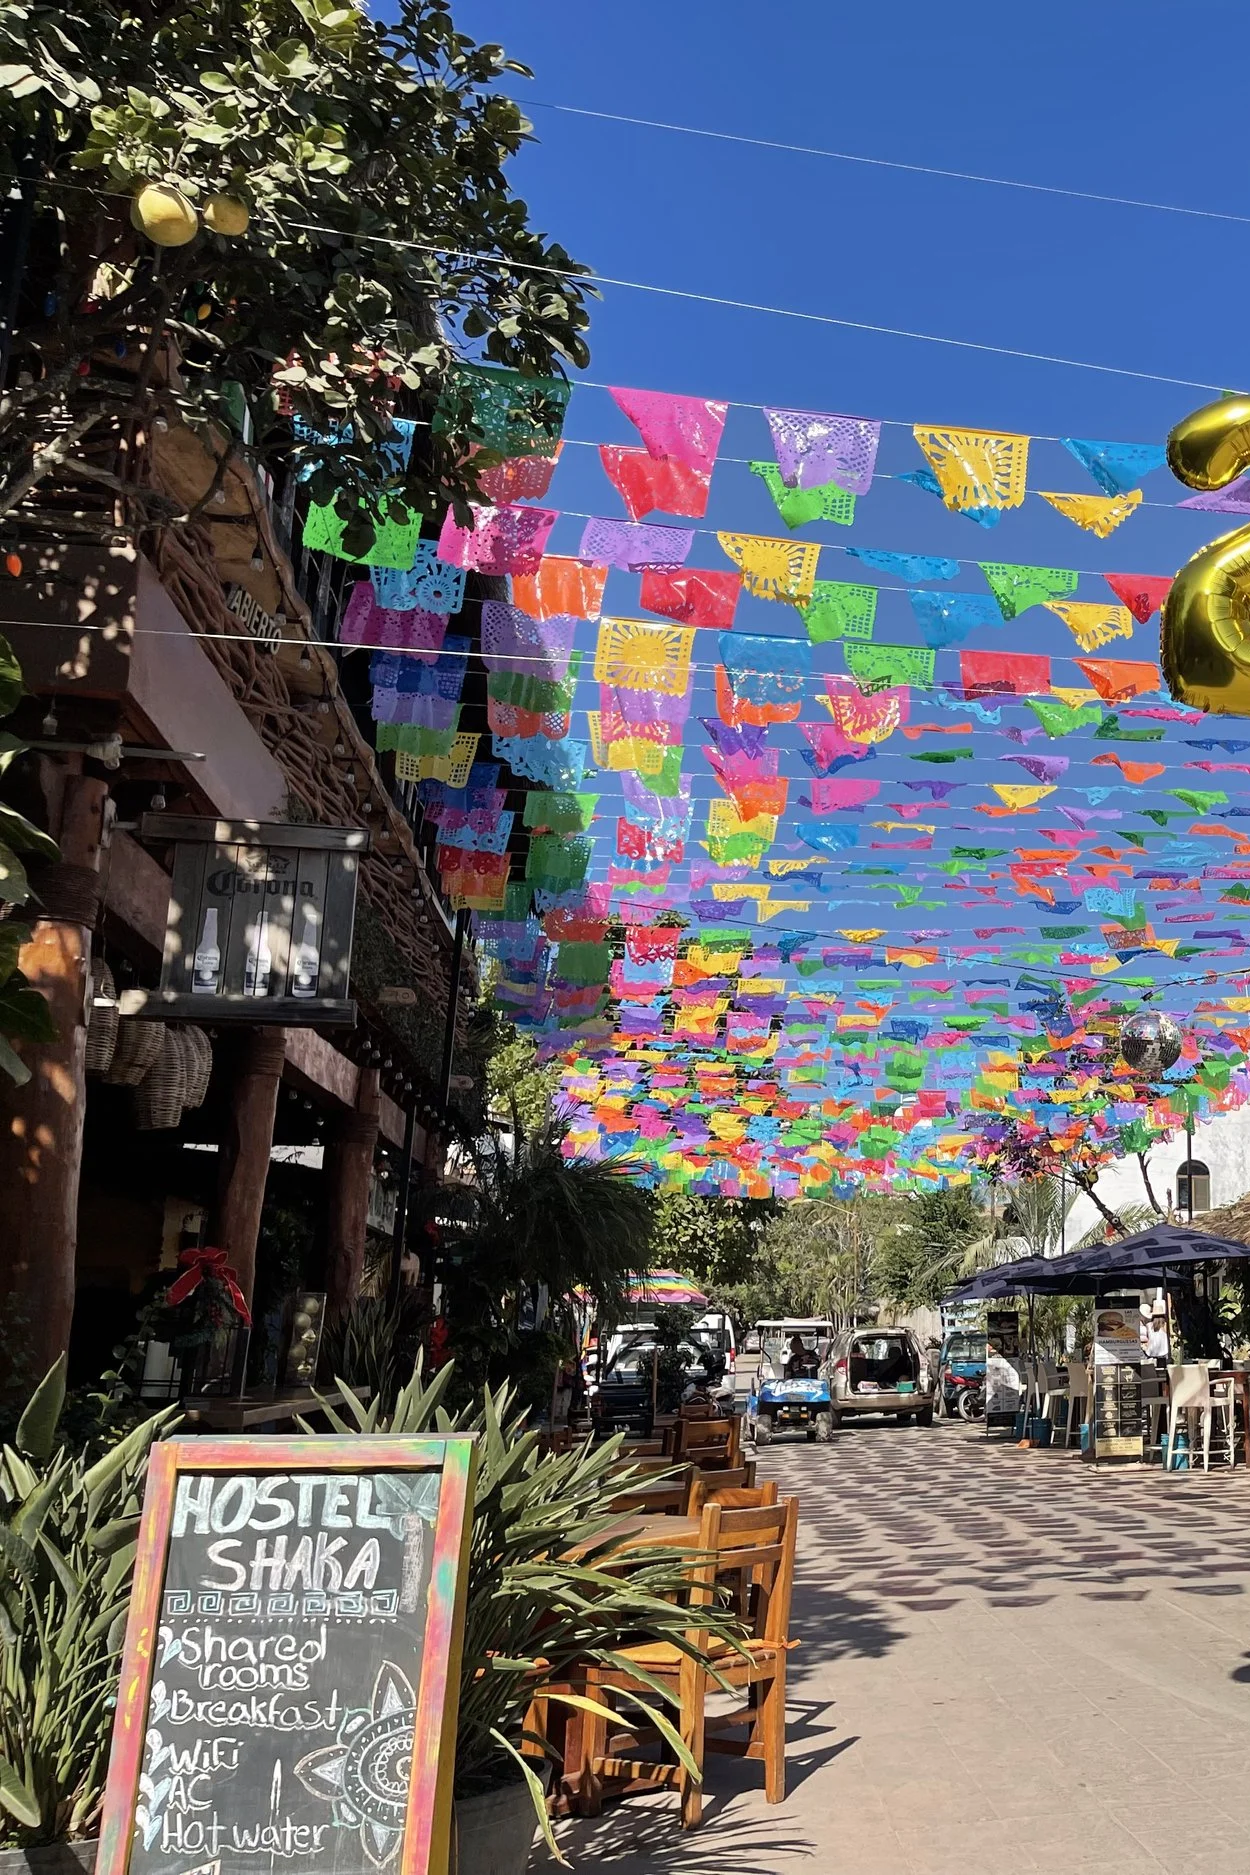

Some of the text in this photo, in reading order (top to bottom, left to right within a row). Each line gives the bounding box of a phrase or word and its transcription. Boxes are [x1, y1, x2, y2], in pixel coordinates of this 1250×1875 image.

[230, 589, 282, 655] ABIERTO
[206, 869, 314, 898] Corona
[171, 1475, 392, 1538] HOSTEL
[200, 1531, 381, 1592] SHAKA
[179, 1624, 327, 1667] Shared
[200, 1660, 311, 1690] rooms
[170, 1689, 348, 1730] Breakfast
[167, 1774, 213, 1813] AC
[232, 1814, 331, 1854] water
